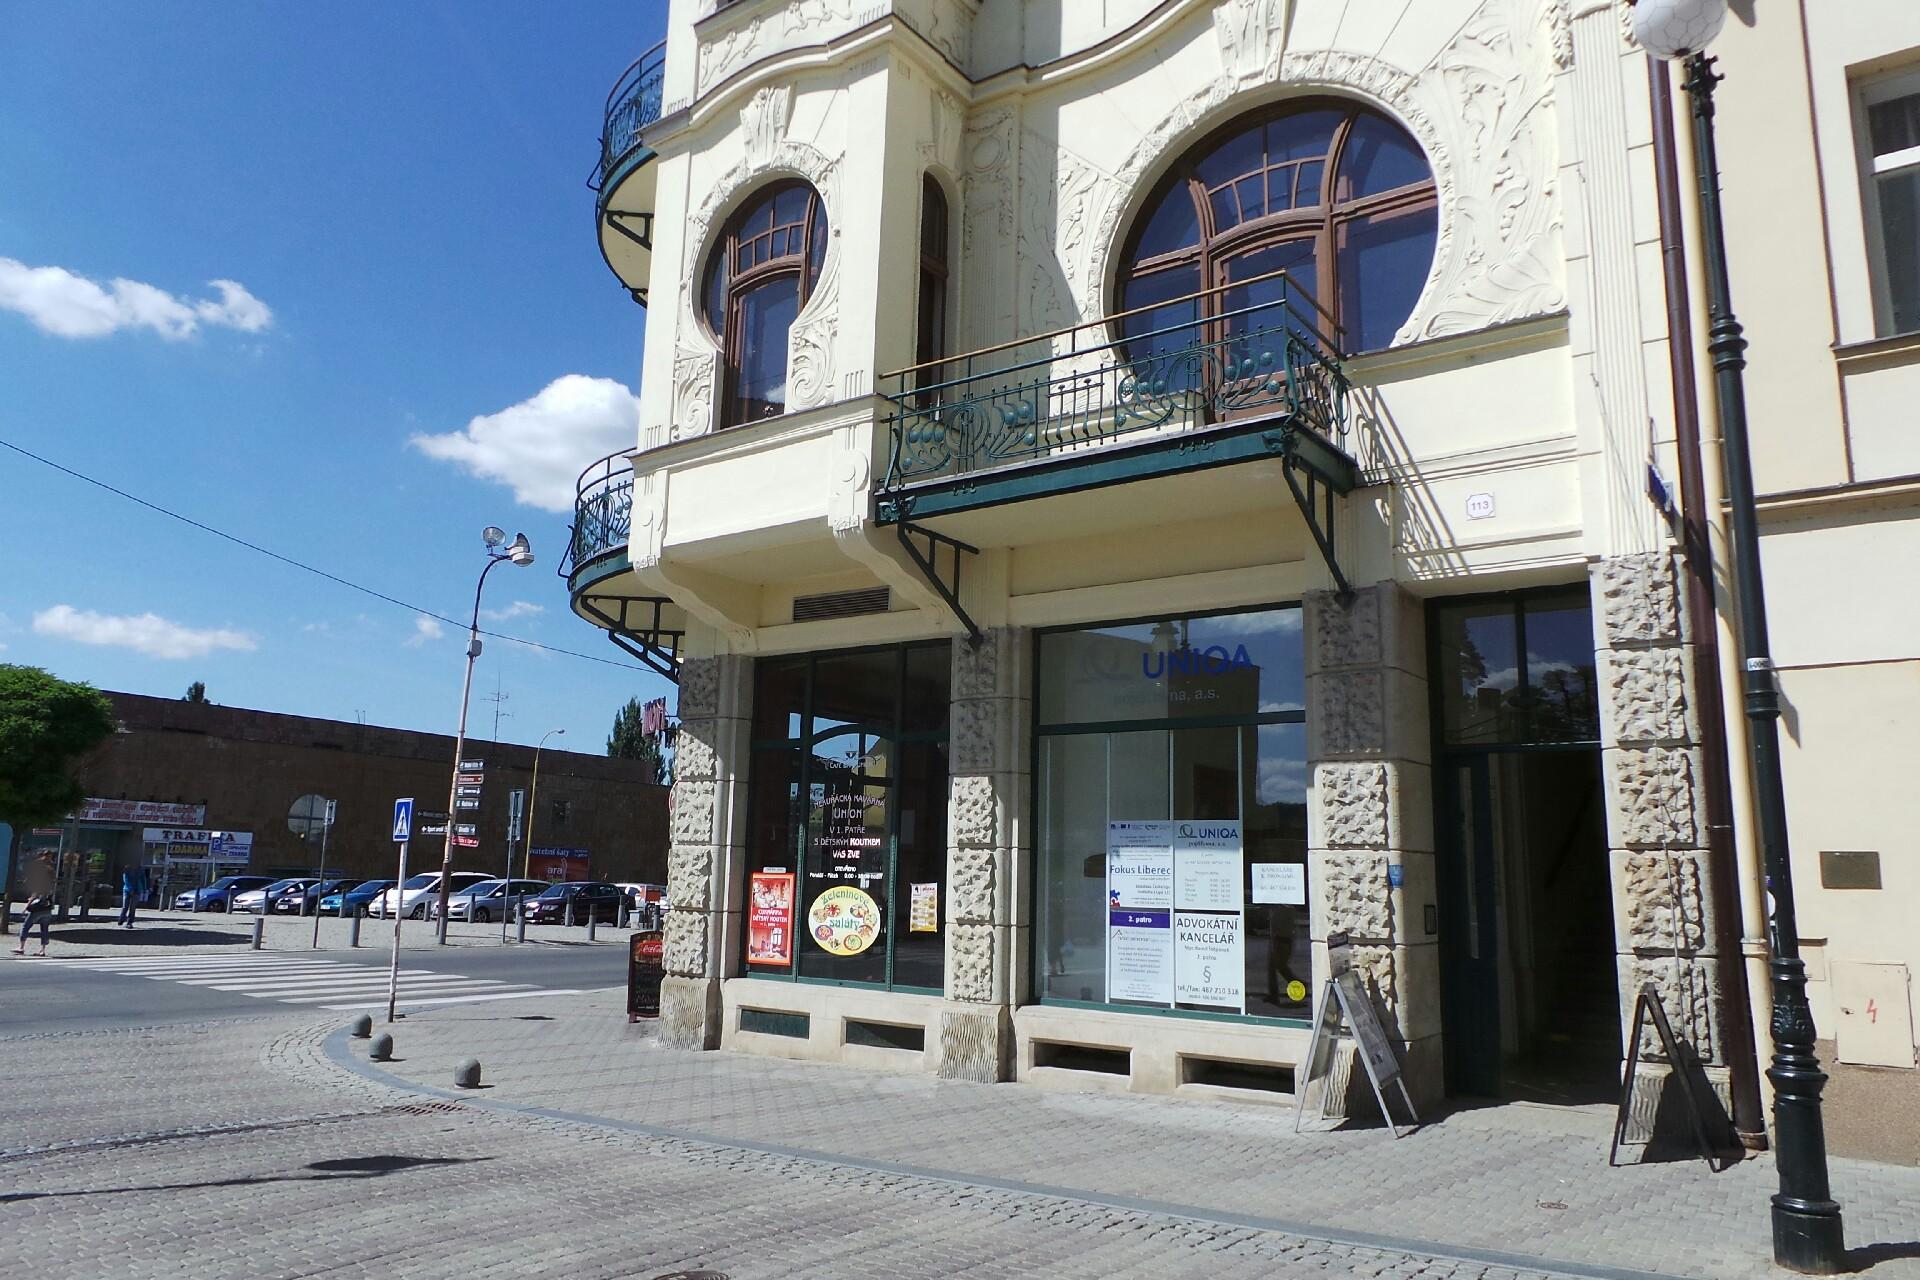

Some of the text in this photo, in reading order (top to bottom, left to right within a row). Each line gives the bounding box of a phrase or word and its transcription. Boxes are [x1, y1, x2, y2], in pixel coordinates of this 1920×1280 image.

[1471, 501, 1489, 510] 113
[1143, 644, 1256, 679] UNIQA
[844, 824, 866, 834] PATŘE
[1199, 827, 1239, 839] UNIQA
[850, 837, 881, 847] KOUTKEM
[847, 850, 861, 859] ZVE
[547, 867, 563, 875] ara
[1110, 865, 1171, 875] Fokus Liberec
[1128, 915, 1135, 923] 2.
[1176, 917, 1239, 931] ADVOKÁTNÍ
[829, 918, 861, 932] saláty
[1180, 931, 1235, 945] KANCELÁŘ
